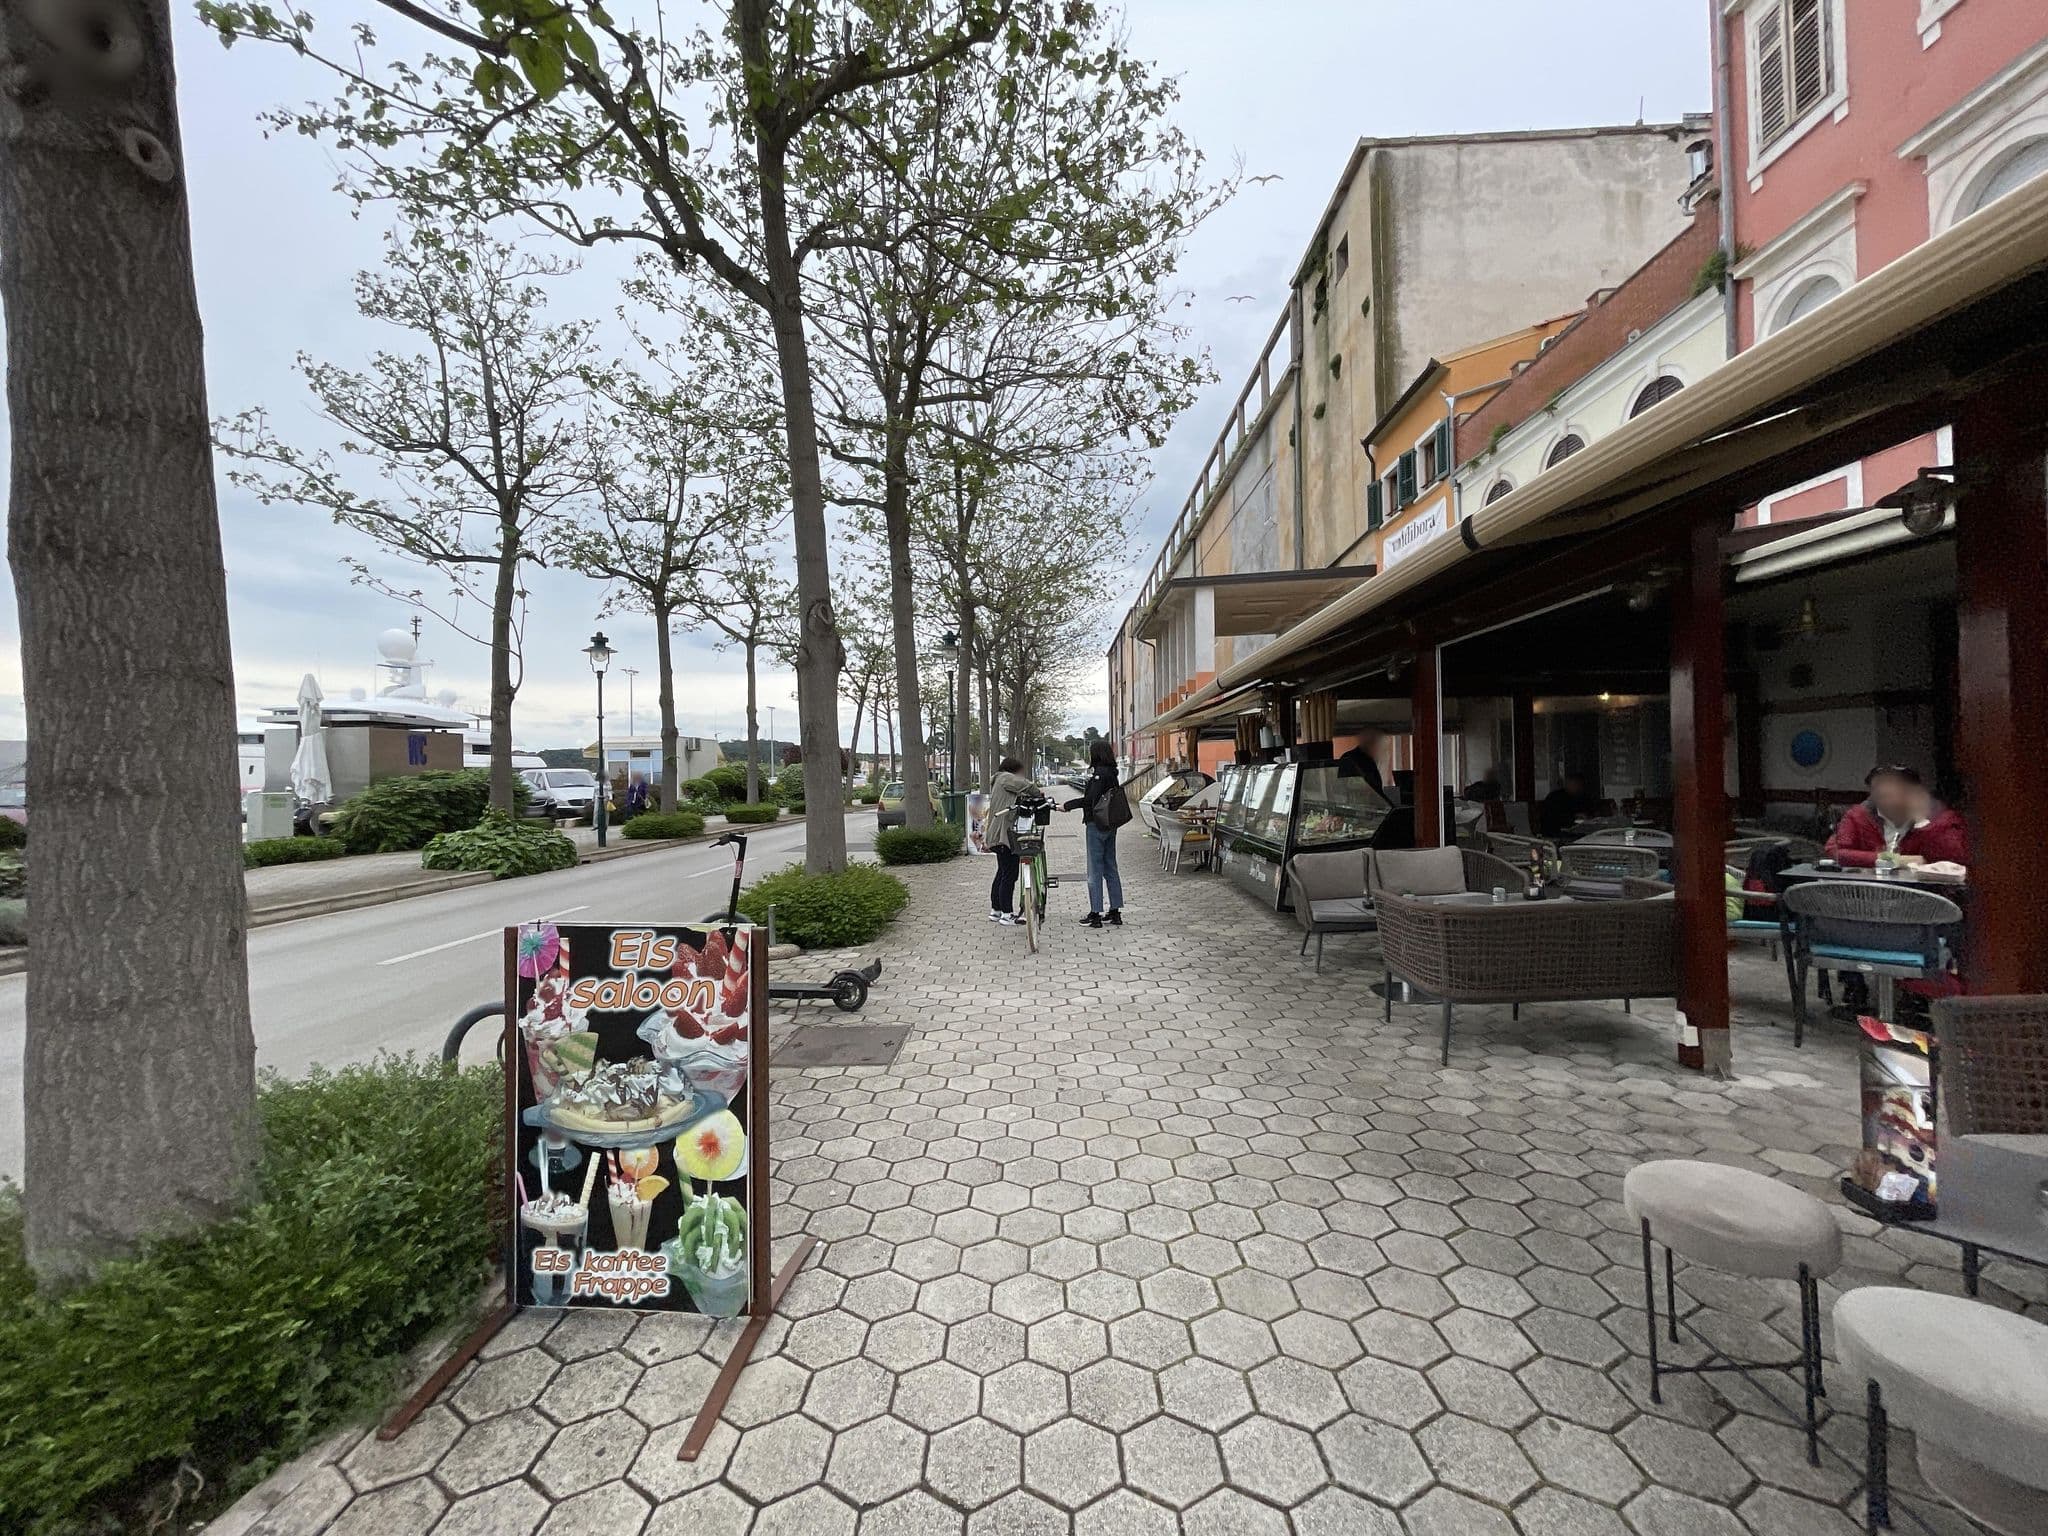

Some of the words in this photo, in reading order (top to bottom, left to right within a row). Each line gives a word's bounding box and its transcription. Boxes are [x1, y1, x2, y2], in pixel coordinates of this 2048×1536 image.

[610, 931, 675, 969] Eis
[571, 973, 716, 1009] saloon
[534, 1250, 571, 1272] Eis
[583, 1251, 667, 1273] kaffee
[573, 1272, 668, 1300] Frappe
